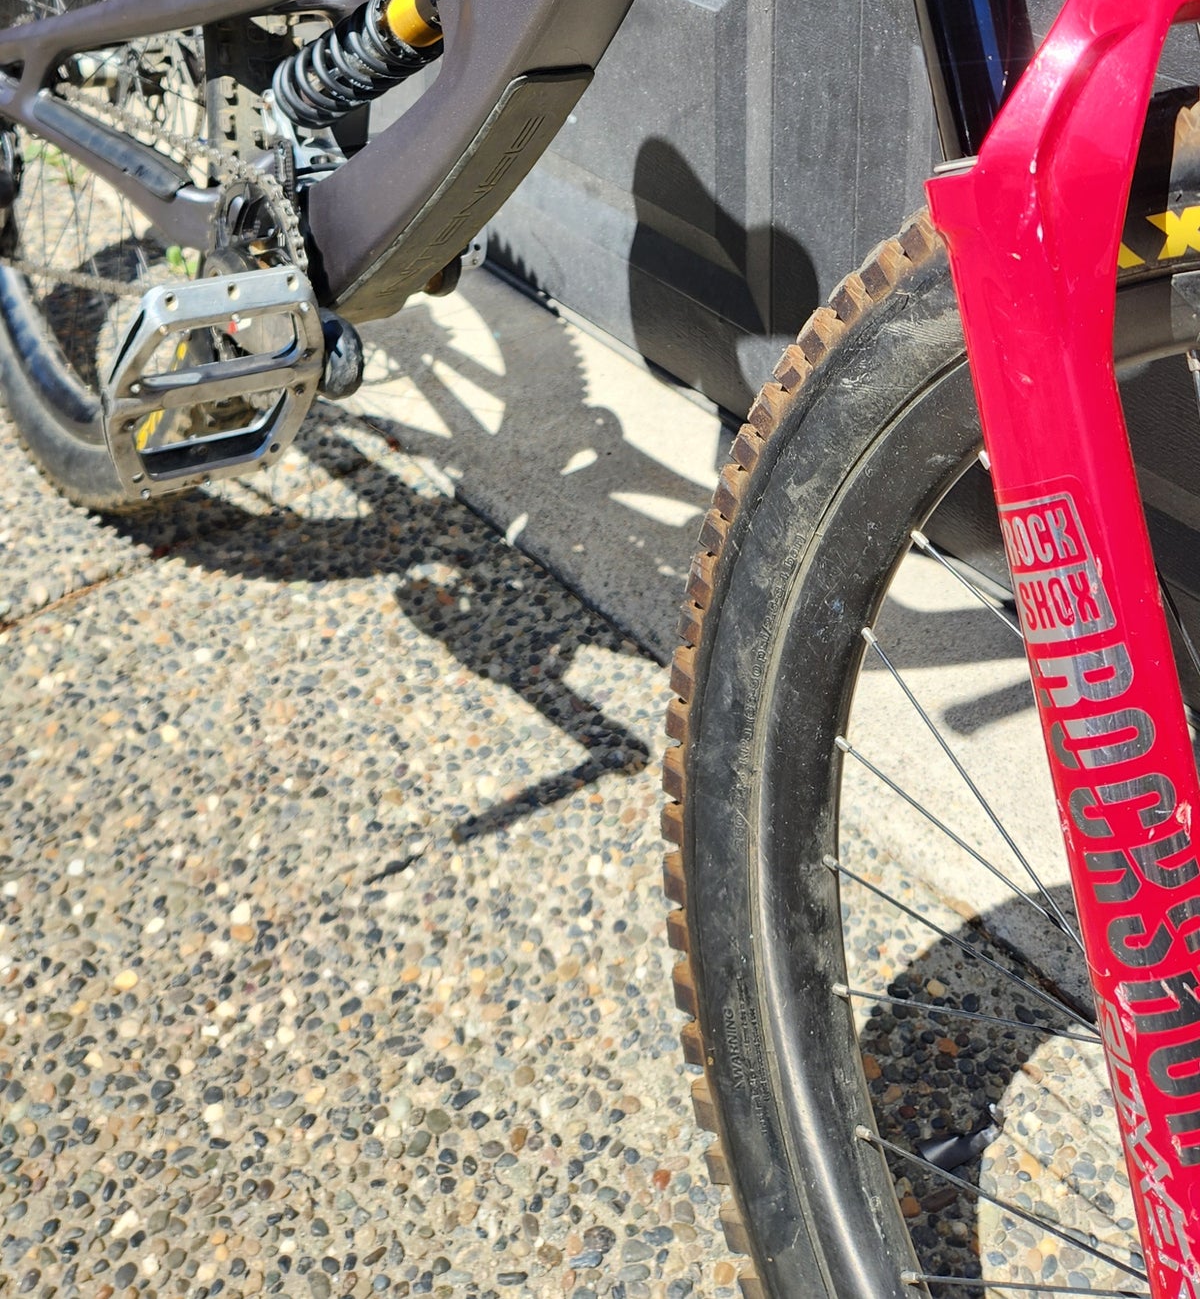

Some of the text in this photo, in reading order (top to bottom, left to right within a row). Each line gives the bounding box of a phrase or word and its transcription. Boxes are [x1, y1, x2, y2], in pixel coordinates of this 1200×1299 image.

[376, 116, 545, 298] INTENSE
[1001, 507, 1079, 567] ROCK
[1018, 569, 1103, 631] SHOX
[723, 1006, 745, 1081] WARNING
